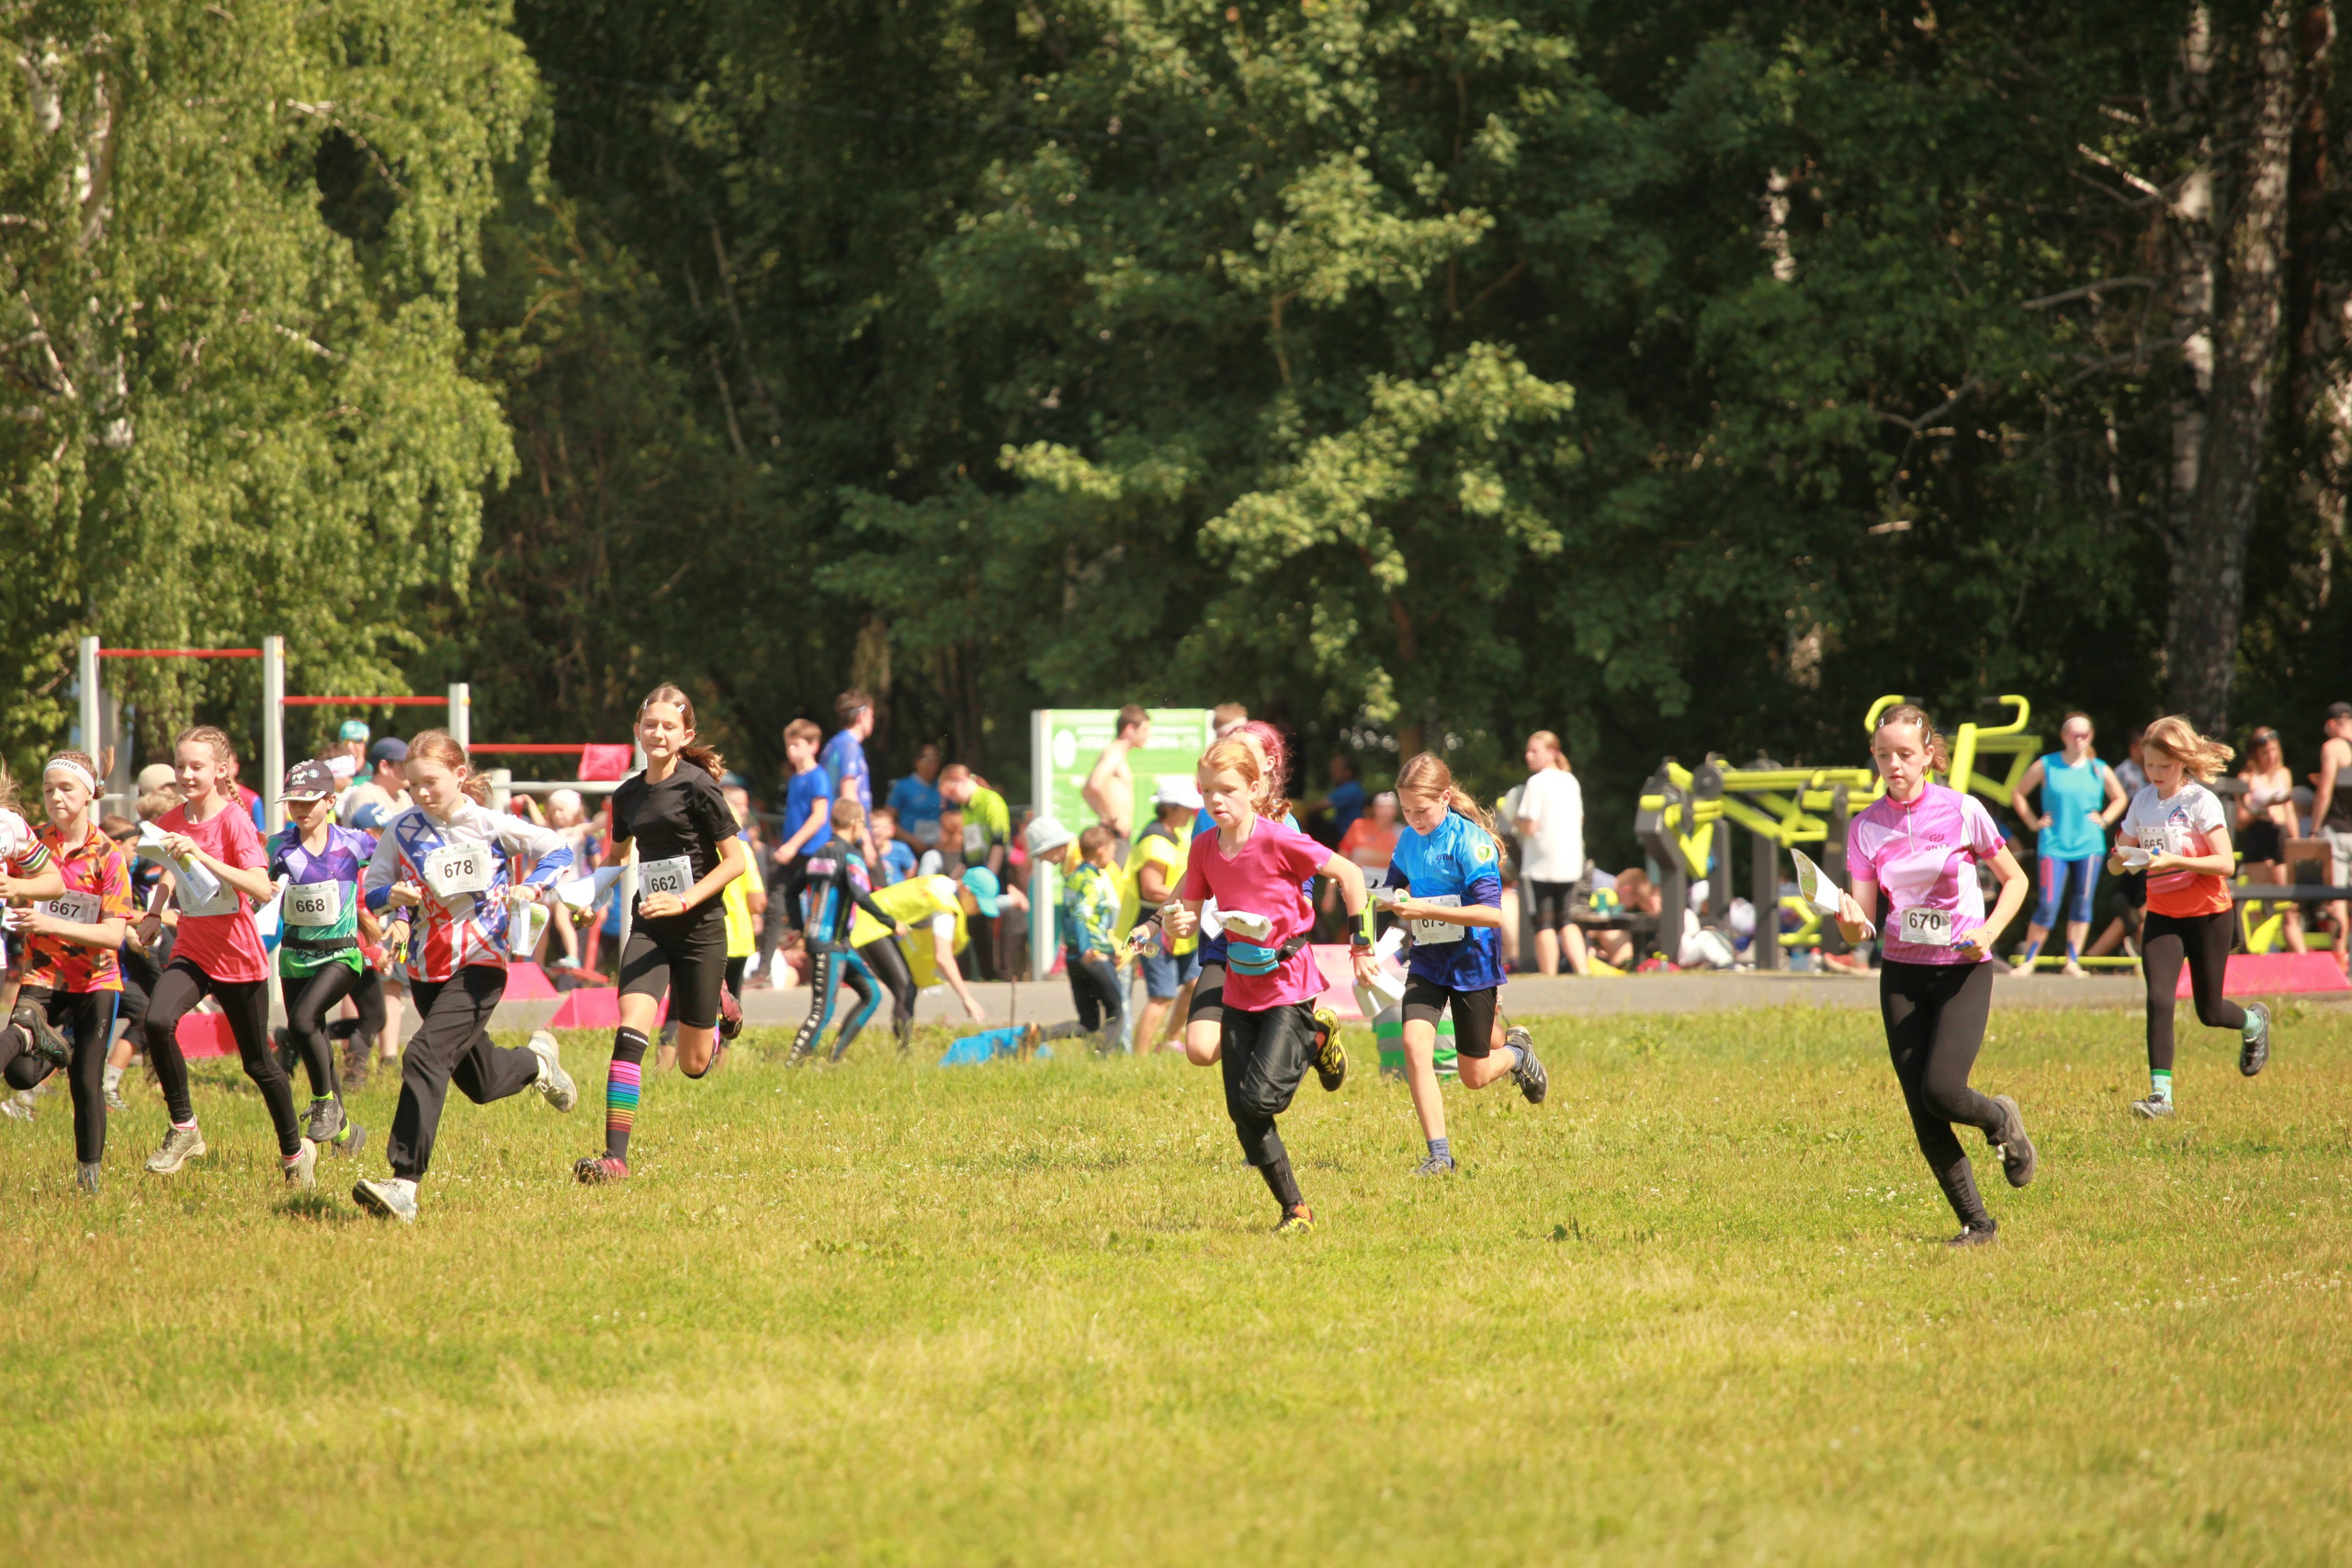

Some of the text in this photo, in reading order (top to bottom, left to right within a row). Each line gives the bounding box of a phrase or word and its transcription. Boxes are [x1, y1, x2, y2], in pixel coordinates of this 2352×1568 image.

[1926, 842, 1951, 852] ONYX
[2142, 838, 2165, 850] 665
[444, 859, 474, 878] 678
[650, 874, 678, 893] 662
[49, 899, 81, 918] 667
[295, 897, 325, 913] 668
[1908, 912, 1940, 931] 670
